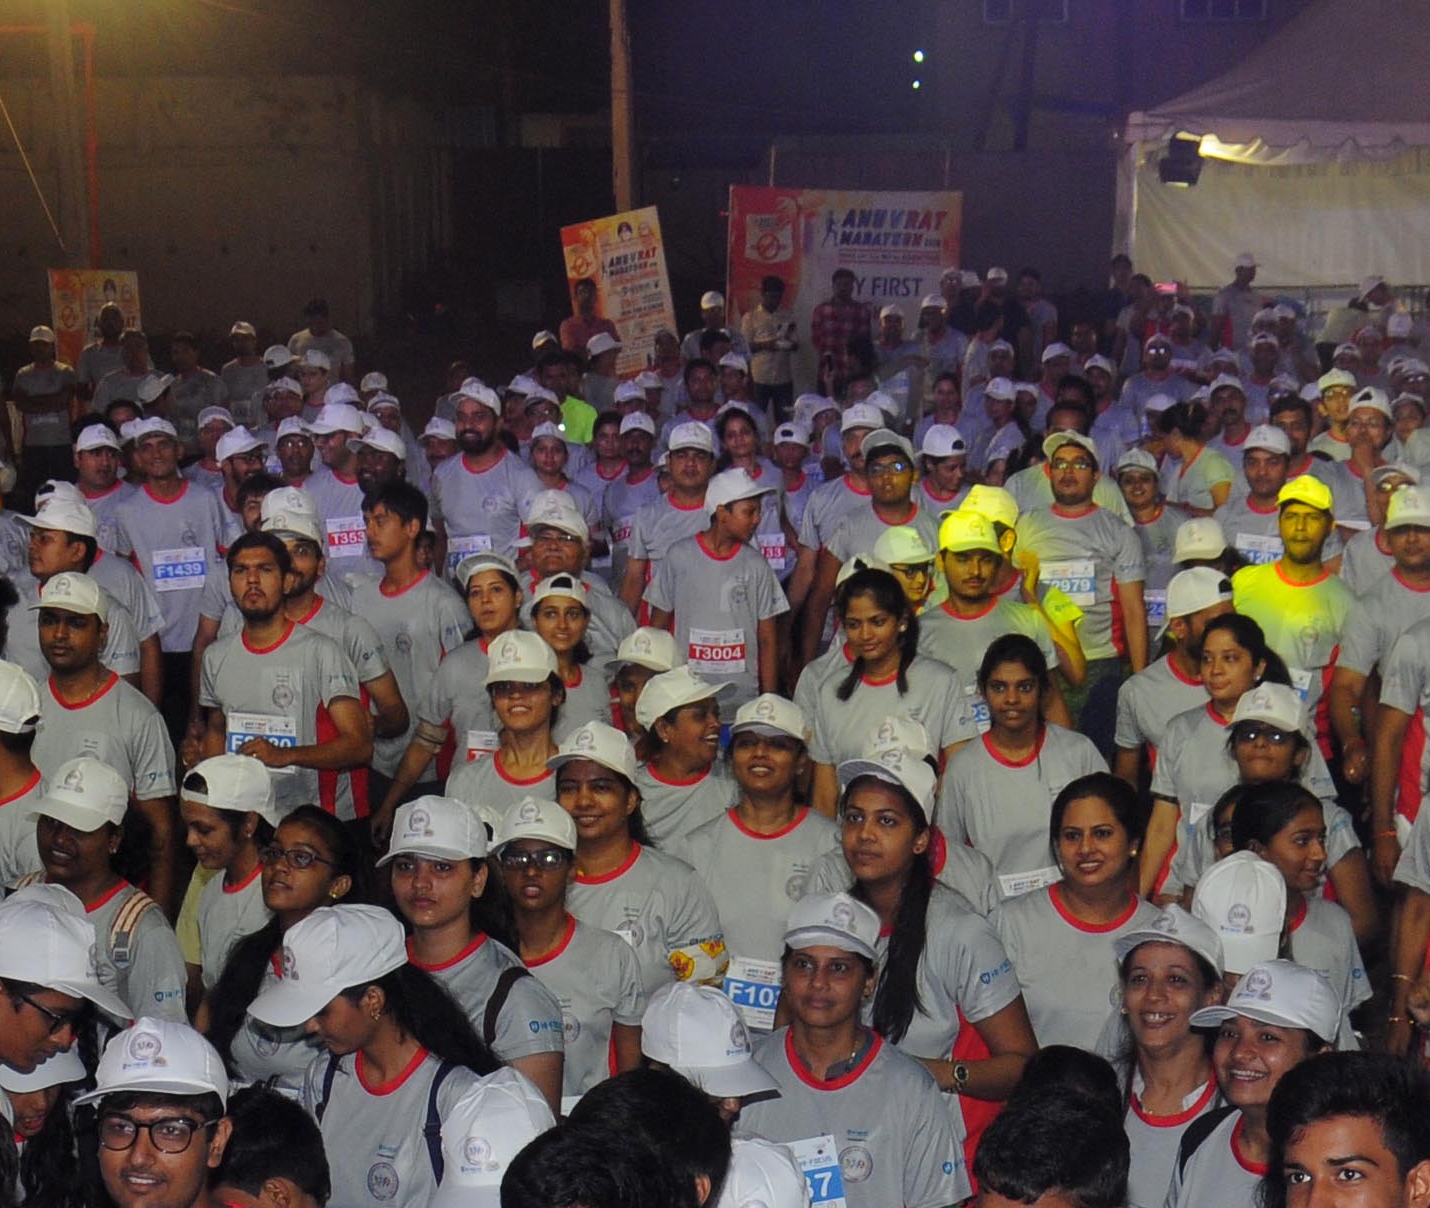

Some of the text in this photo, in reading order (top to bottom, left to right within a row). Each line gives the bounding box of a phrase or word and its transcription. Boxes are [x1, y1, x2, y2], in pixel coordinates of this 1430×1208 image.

[841, 209, 947, 230] ANUVRAT
[872, 277, 923, 297] FIRST
[331, 532, 365, 544] T353
[155, 563, 203, 579] F1439
[1041, 579, 1091, 594] 2979
[693, 645, 742, 660] T3004
